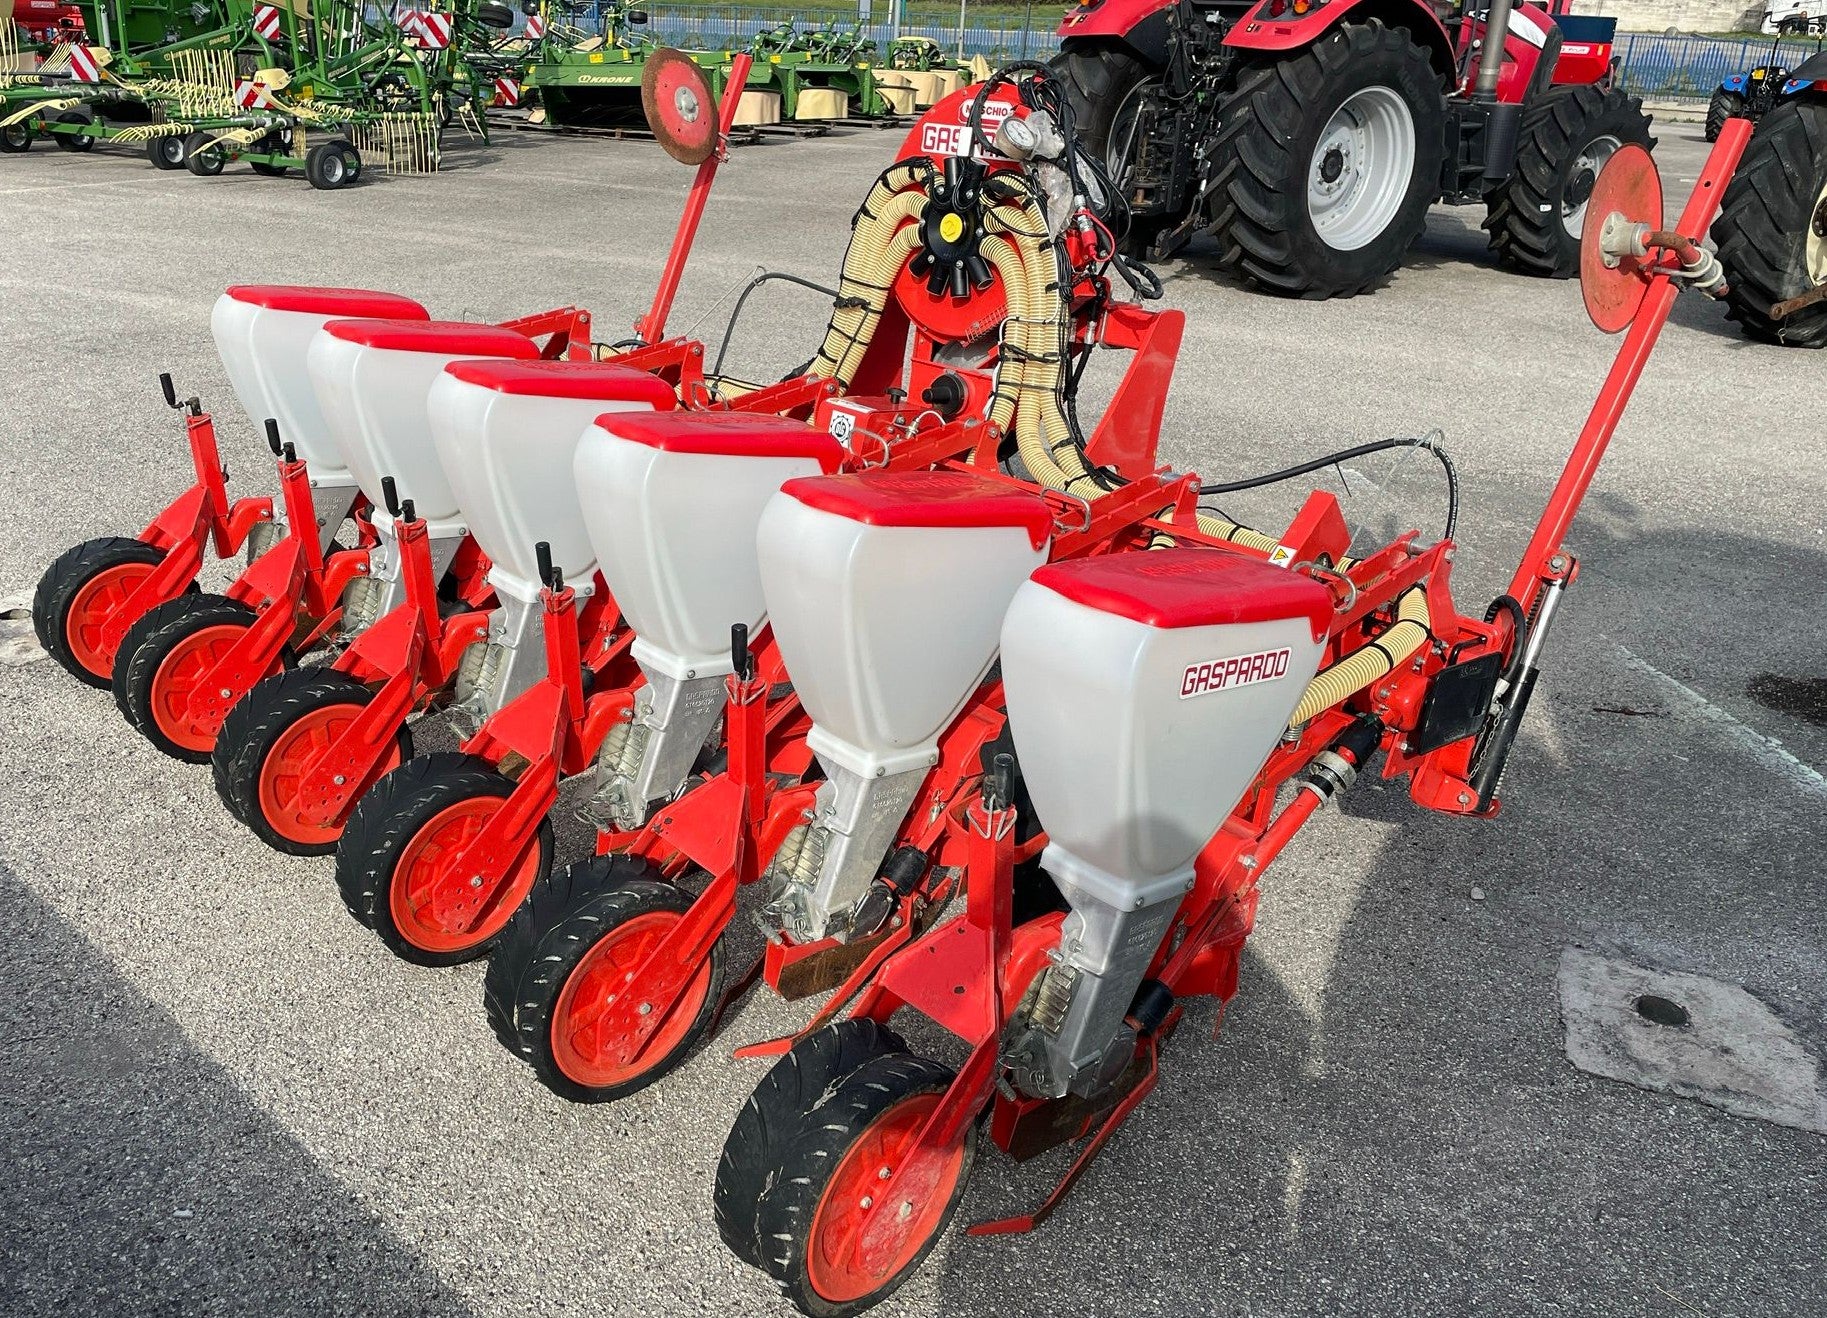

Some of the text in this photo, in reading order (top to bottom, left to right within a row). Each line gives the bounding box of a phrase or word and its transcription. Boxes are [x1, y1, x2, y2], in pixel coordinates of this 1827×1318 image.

[590, 76, 633, 84] KRONE
[965, 104, 1008, 117] MSCHIO
[1181, 649, 1289, 696] GASPARDO
